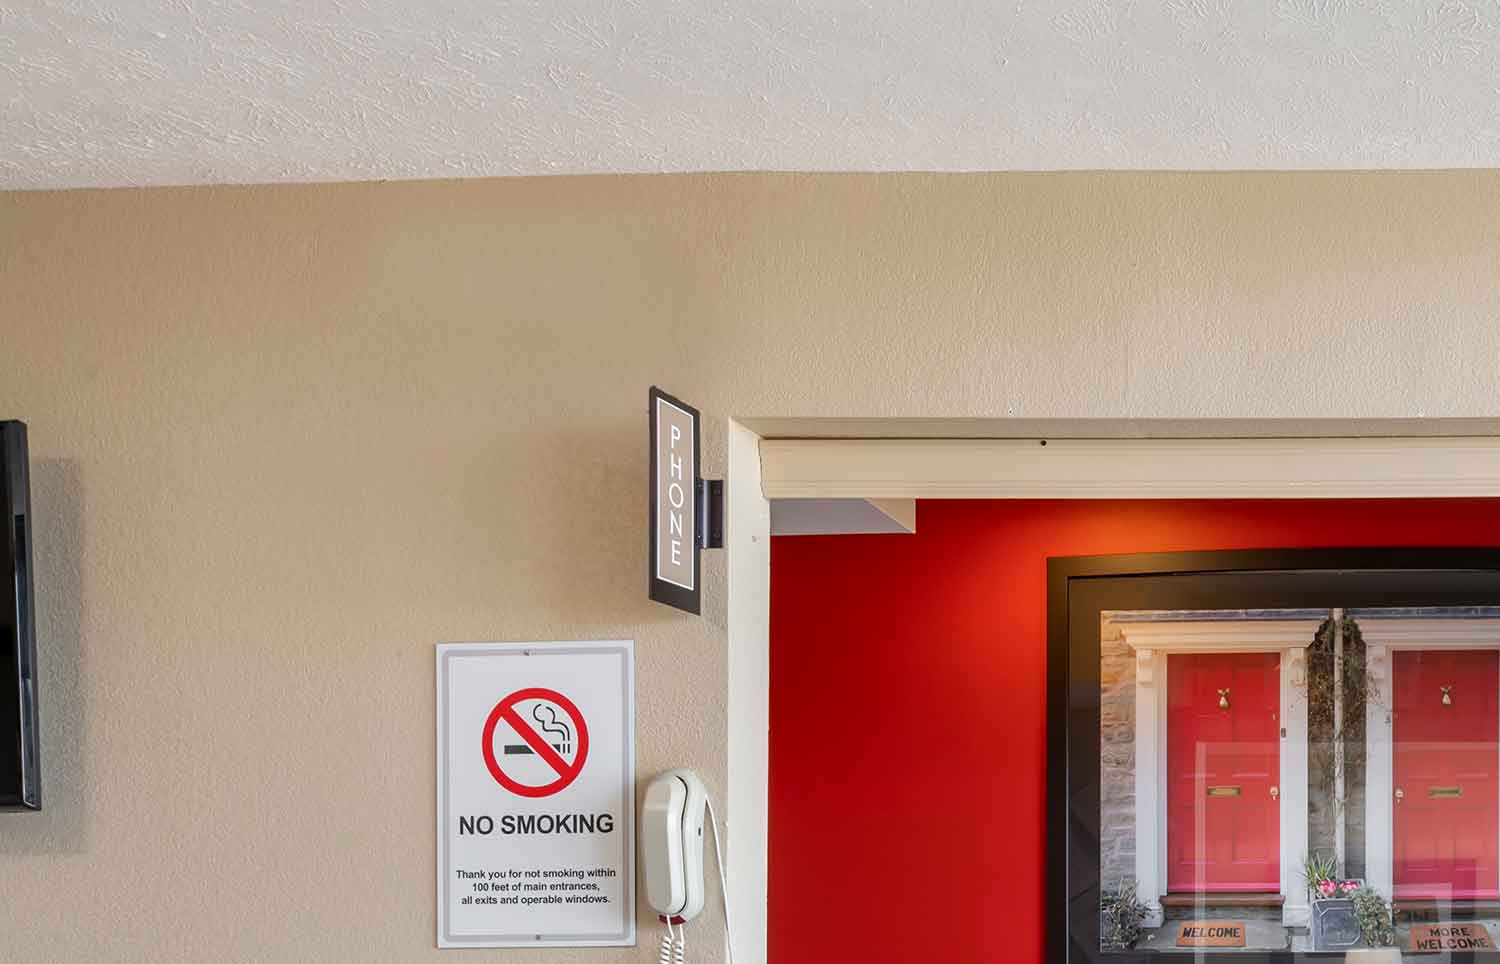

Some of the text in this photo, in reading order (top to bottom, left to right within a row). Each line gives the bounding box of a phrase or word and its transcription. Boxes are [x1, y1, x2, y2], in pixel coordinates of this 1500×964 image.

[669, 424, 684, 566] PHONE
[459, 813, 614, 835] NO SMOKING
[456, 868, 616, 880] Thank you for not smoking within
[472, 882, 600, 892] 100 feet of main entrances,
[461, 894, 611, 906] all exits and operable windows.
[1182, 926, 1241, 938] WELCOME
[1430, 927, 1470, 937] MORE
[1416, 937, 1488, 950] WELCOME
